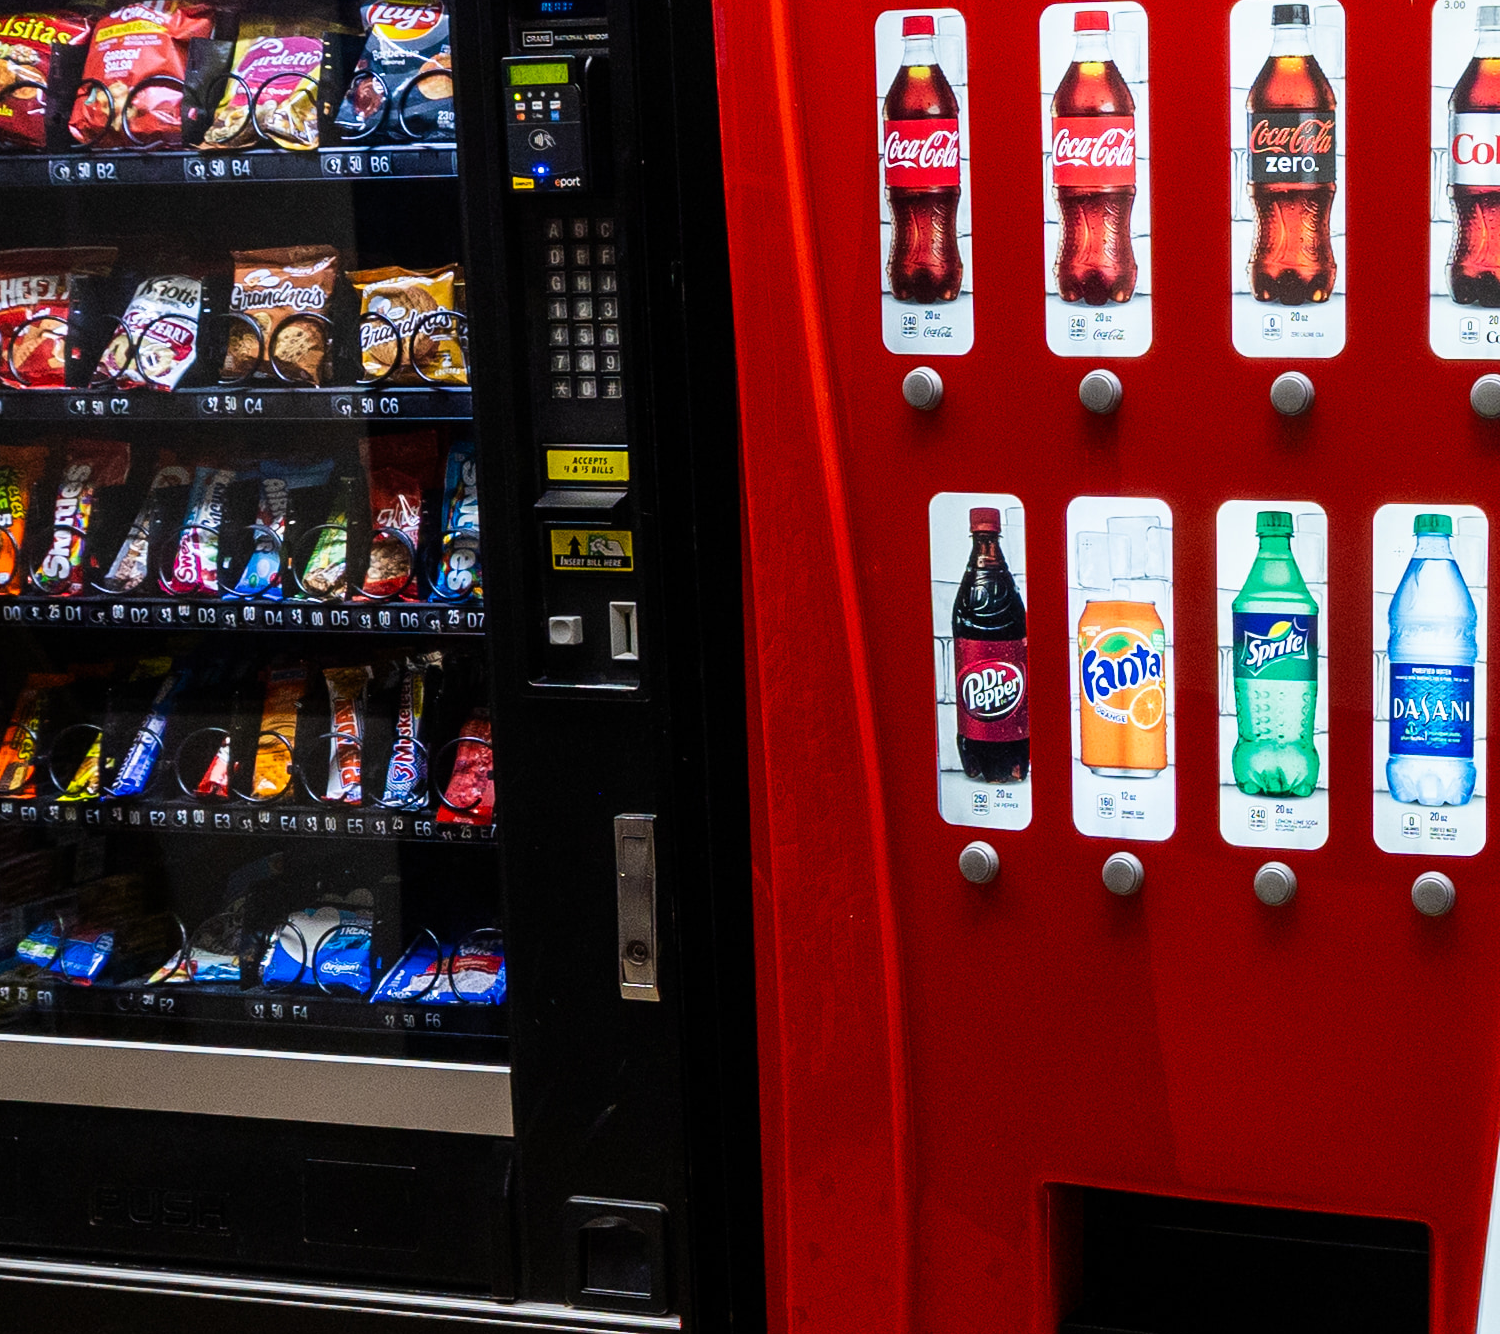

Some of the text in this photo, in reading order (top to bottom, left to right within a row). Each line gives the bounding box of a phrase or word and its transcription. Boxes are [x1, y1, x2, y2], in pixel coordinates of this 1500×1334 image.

[1444, 0, 1466, 10] 3.00
[371, 3, 437, 29] Lay's
[1250, 119, 1336, 154] Coca-Cola
[884, 130, 960, 168] Coca-Cola
[1052, 128, 1135, 167] Coca-Cola
[96, 163, 115, 179] B2
[232, 160, 251, 177] B4
[371, 156, 390, 172] B6
[554, 176, 581, 189] eport
[230, 281, 328, 312] Grandma's
[554, 303, 560, 316] 1
[578, 302, 588, 316] 2
[604, 302, 612, 316] 3
[925, 311, 933, 320] 20
[903, 316, 917, 327] 240
[1071, 318, 1086, 328] 240
[1489, 315, 1499, 325] 20
[360, 305, 452, 352] Grandma's
[554, 329, 564, 342] 4
[579, 329, 588, 342] 5
[605, 328, 614, 342] 6
[556, 355, 564, 369] 7
[581, 355, 590, 369] 8
[606, 355, 615, 369] 9
[111, 398, 129, 415] C2
[244, 398, 263, 414] C4
[379, 397, 399, 414] C6
[572, 457, 608, 465] ACCEPTS
[592, 466, 614, 474] BILLS
[560, 556, 621, 567] INSERT BILL HERE
[330, 610, 349, 626] D5
[400, 612, 419, 628] D6
[467, 612, 485, 628] D7
[1246, 630, 1304, 667] Sprite
[982, 668, 1007, 690] Dr
[1082, 643, 1163, 704] Fanta
[963, 671, 1020, 711] Pepper
[1096, 706, 1128, 723] ORANGE
[1393, 692, 1470, 725] DASANI
[974, 794, 988, 804] 250
[996, 789, 1005, 799] 20
[1251, 809, 1266, 819] 240
[1409, 816, 1415, 826] 0
[1429, 812, 1439, 821] 20
[347, 819, 364, 835] E5
[414, 821, 432, 837] E6
